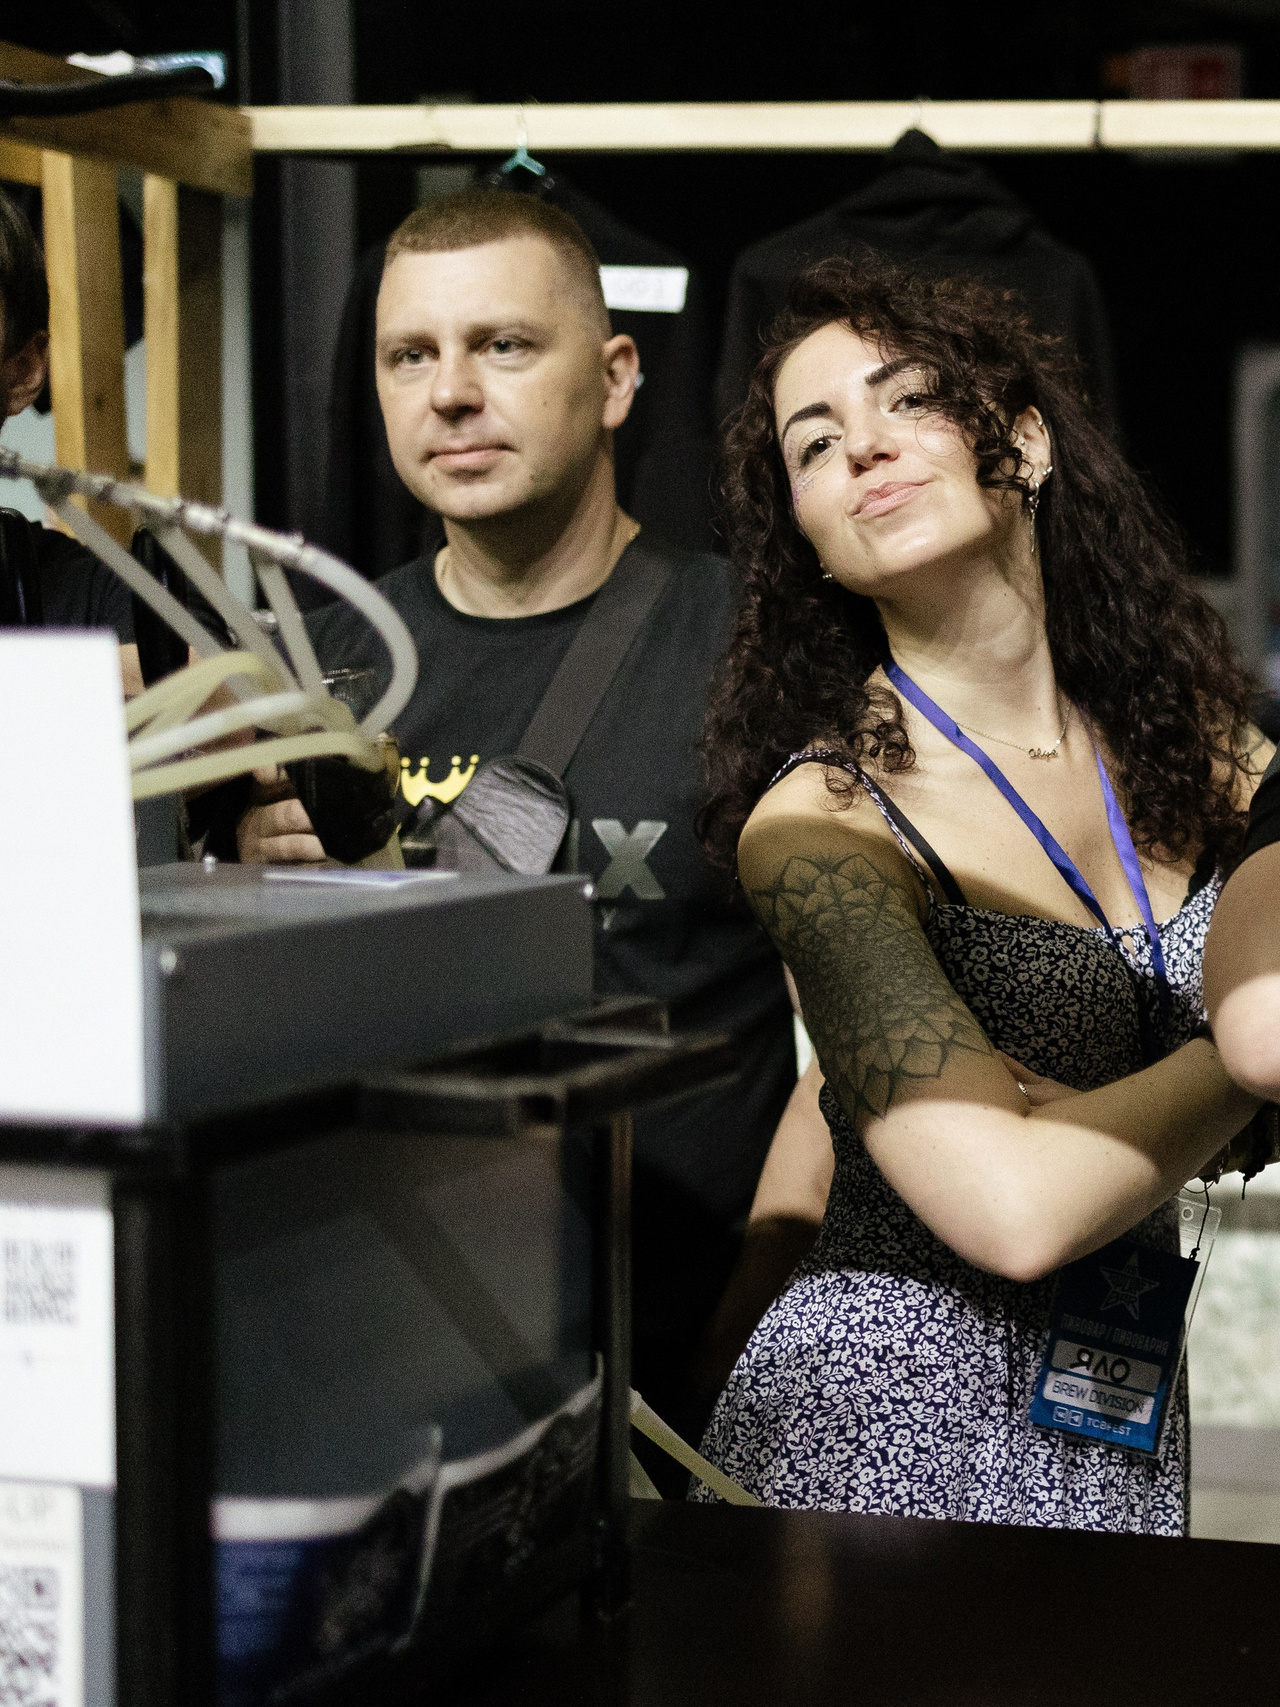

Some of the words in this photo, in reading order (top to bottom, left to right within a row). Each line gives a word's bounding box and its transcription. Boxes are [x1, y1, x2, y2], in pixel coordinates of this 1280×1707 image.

[571, 817, 669, 900] X
[1052, 1380, 1088, 1399] BREW
[1089, 1389, 1144, 1414] DIVISION
